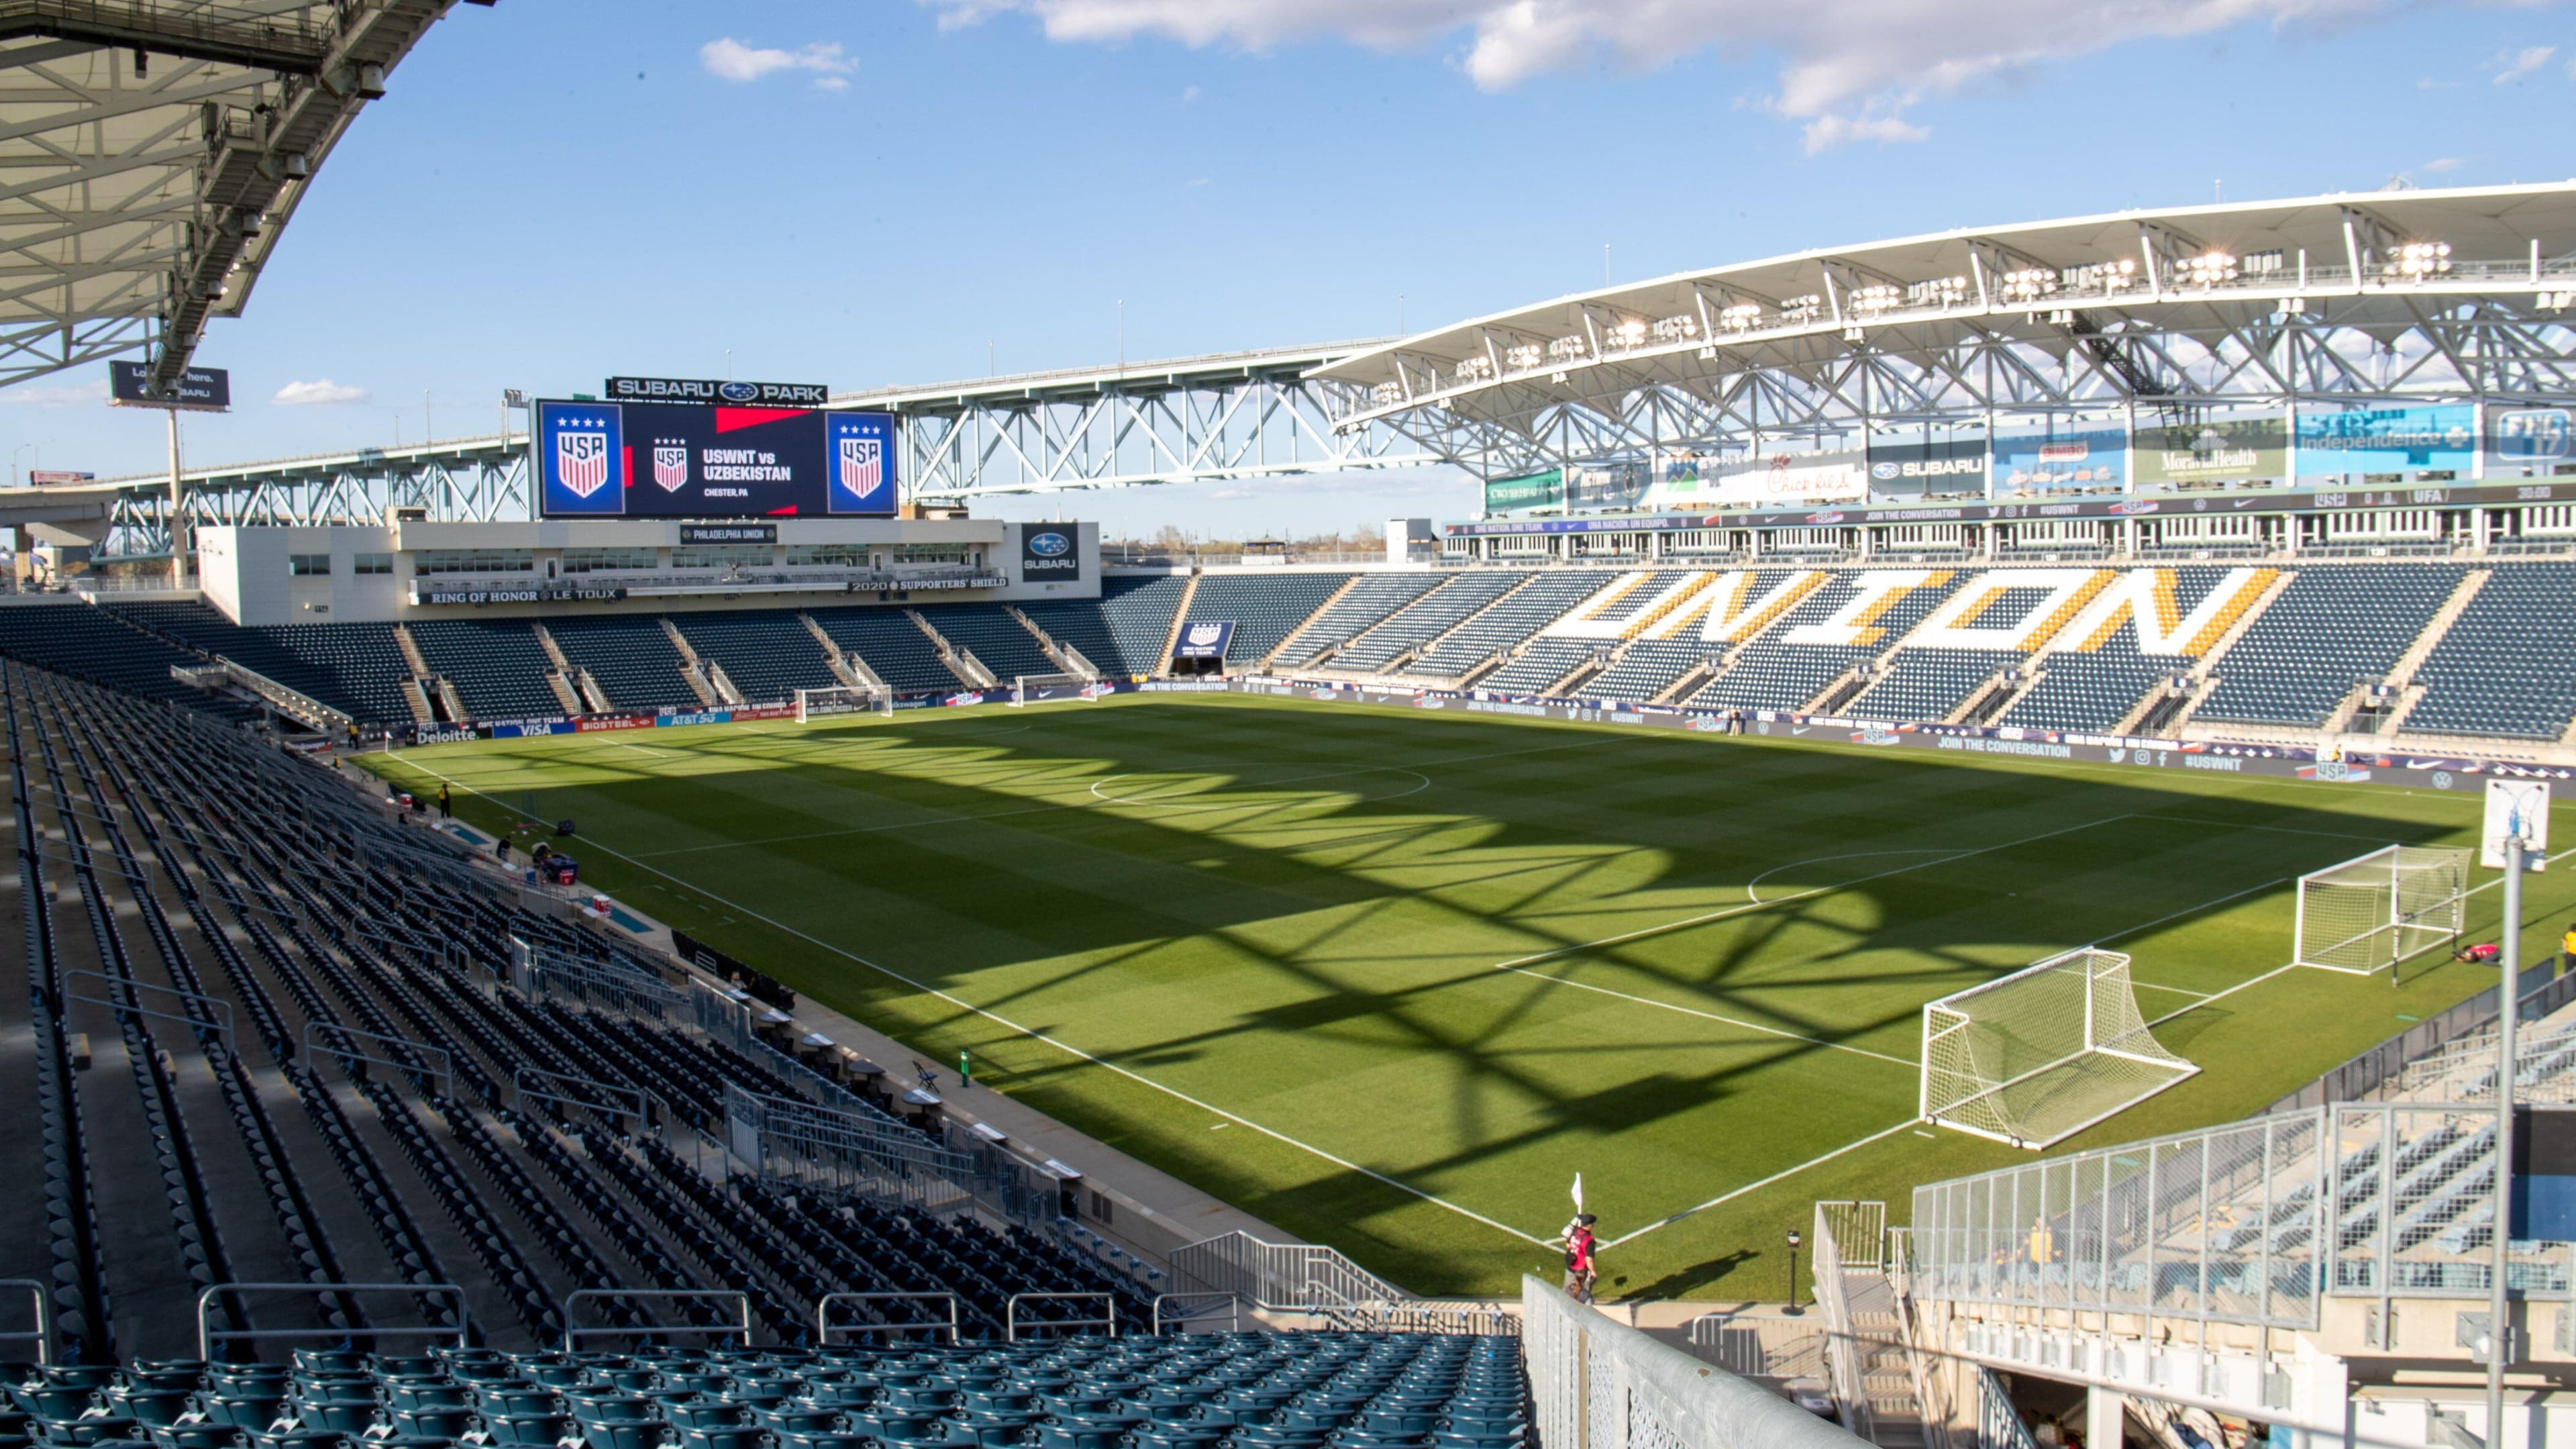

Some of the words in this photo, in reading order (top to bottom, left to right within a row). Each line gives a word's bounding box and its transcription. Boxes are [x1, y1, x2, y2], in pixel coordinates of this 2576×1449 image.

[187, 372, 213, 383] here.
[617, 379, 715, 398] SUBARU
[762, 385, 825, 401] PARK
[561, 434, 603, 460] USA
[2300, 430, 2440, 451] Independence
[657, 449, 684, 467] USA
[703, 449, 756, 465] USWNT
[758, 452, 776, 465] vs
[843, 442, 879, 464] USA
[2042, 445, 2085, 457] BIMBO
[703, 464, 792, 481] UZBEKISTAN
[1902, 458, 1983, 475] SUBARU
[704, 488, 737, 497] CHESTER,
[737, 489, 749, 497] PA
[2414, 490, 2442, 503] UFA
[1865, 511, 1881, 521] JOIN
[1883, 510, 1900, 520] THE
[1902, 508, 1961, 519] CONVERSATION
[2041, 504, 2079, 515] #USWNT
[1588, 521, 1602, 530] UNA
[1631, 519, 1641, 529] UN
[694, 529, 741, 540] PHILADELPHIA
[743, 529, 764, 539] UNION
[1023, 559, 1076, 570] SUBARU
[853, 582, 887, 591] 2020
[900, 579, 969, 590] SUPPORTERS'
[971, 577, 1007, 588] SHIELD
[431, 592, 468, 603] RING
[470, 592, 488, 603] OF
[490, 591, 537, 602] HONOR
[554, 591, 573, 600] LE
[575, 589, 617, 599] TOUX
[1541, 568, 2281, 658] UNION
[1139, 683, 1155, 691] JOIN
[1157, 683, 1172, 691] THE
[1172, 682, 1229, 691] CONVERSATION
[957, 693, 972, 703] USA
[1467, 701, 1481, 710] JOIN
[1482, 702, 1494, 712] THE
[1495, 703, 1546, 716] CONVERSATION
[582, 720, 636, 731] BIOSTEEL
[671, 715, 697, 726] AT&T
[699, 714, 716, 723] 5G
[1611, 712, 1644, 725] #USWNT
[1696, 716, 1714, 729] USA
[520, 723, 552, 736] VISA
[1864, 729, 1884, 743] USA
[1938, 736, 1963, 750] JOIN
[1964, 738, 1985, 752] THE
[1986, 741, 2071, 758] CONVERSATION
[2185, 756, 2243, 771] #USWNT
[2318, 763, 2347, 779] USA
